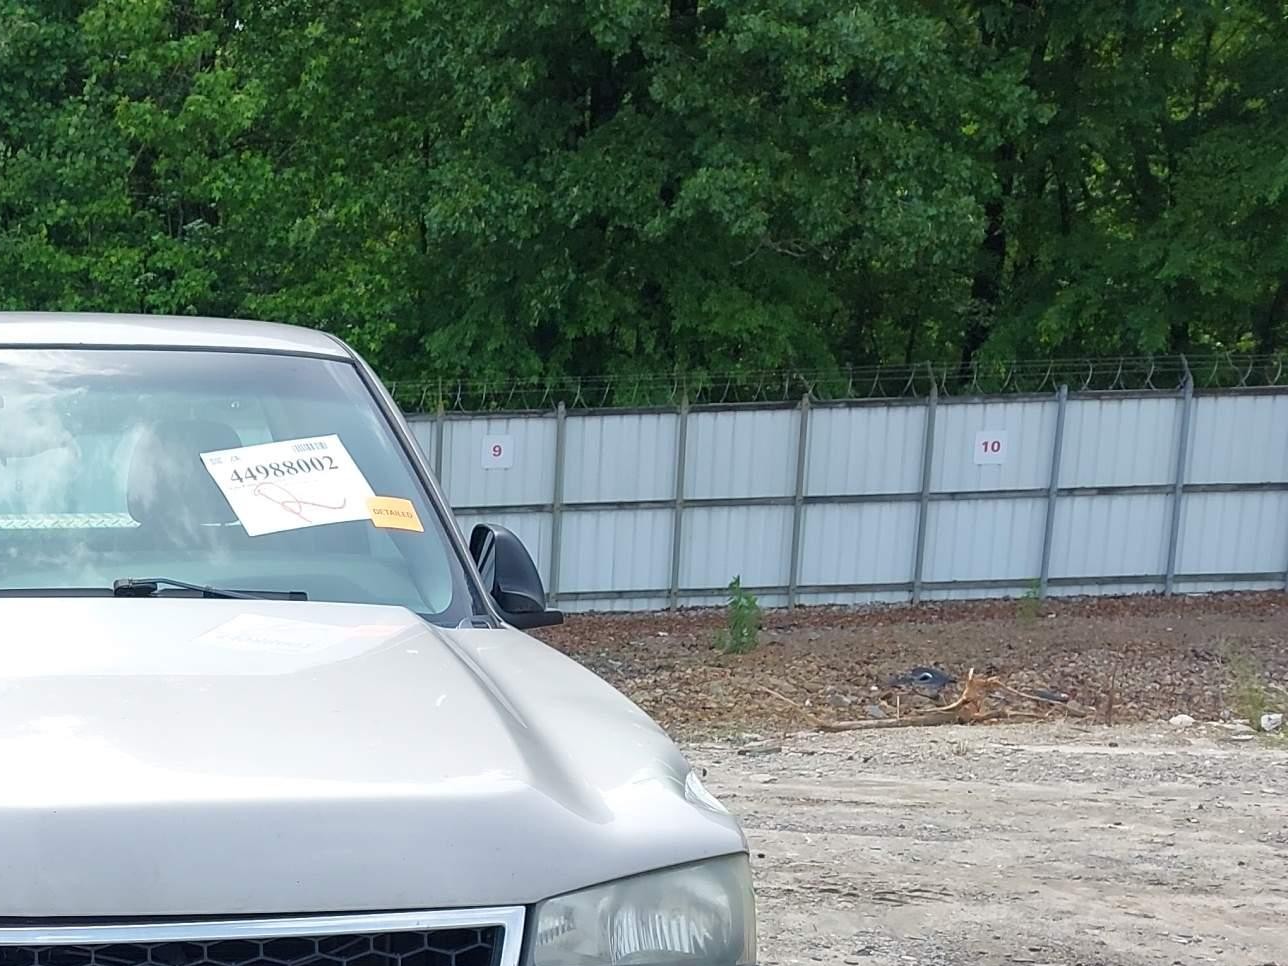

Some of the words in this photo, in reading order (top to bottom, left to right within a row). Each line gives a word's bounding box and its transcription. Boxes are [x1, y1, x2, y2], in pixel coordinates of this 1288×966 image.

[492, 445, 502, 457] 9
[981, 440, 1001, 453] 10
[230, 455, 339, 484] 44988002
[372, 508, 413, 519] DETAILED
